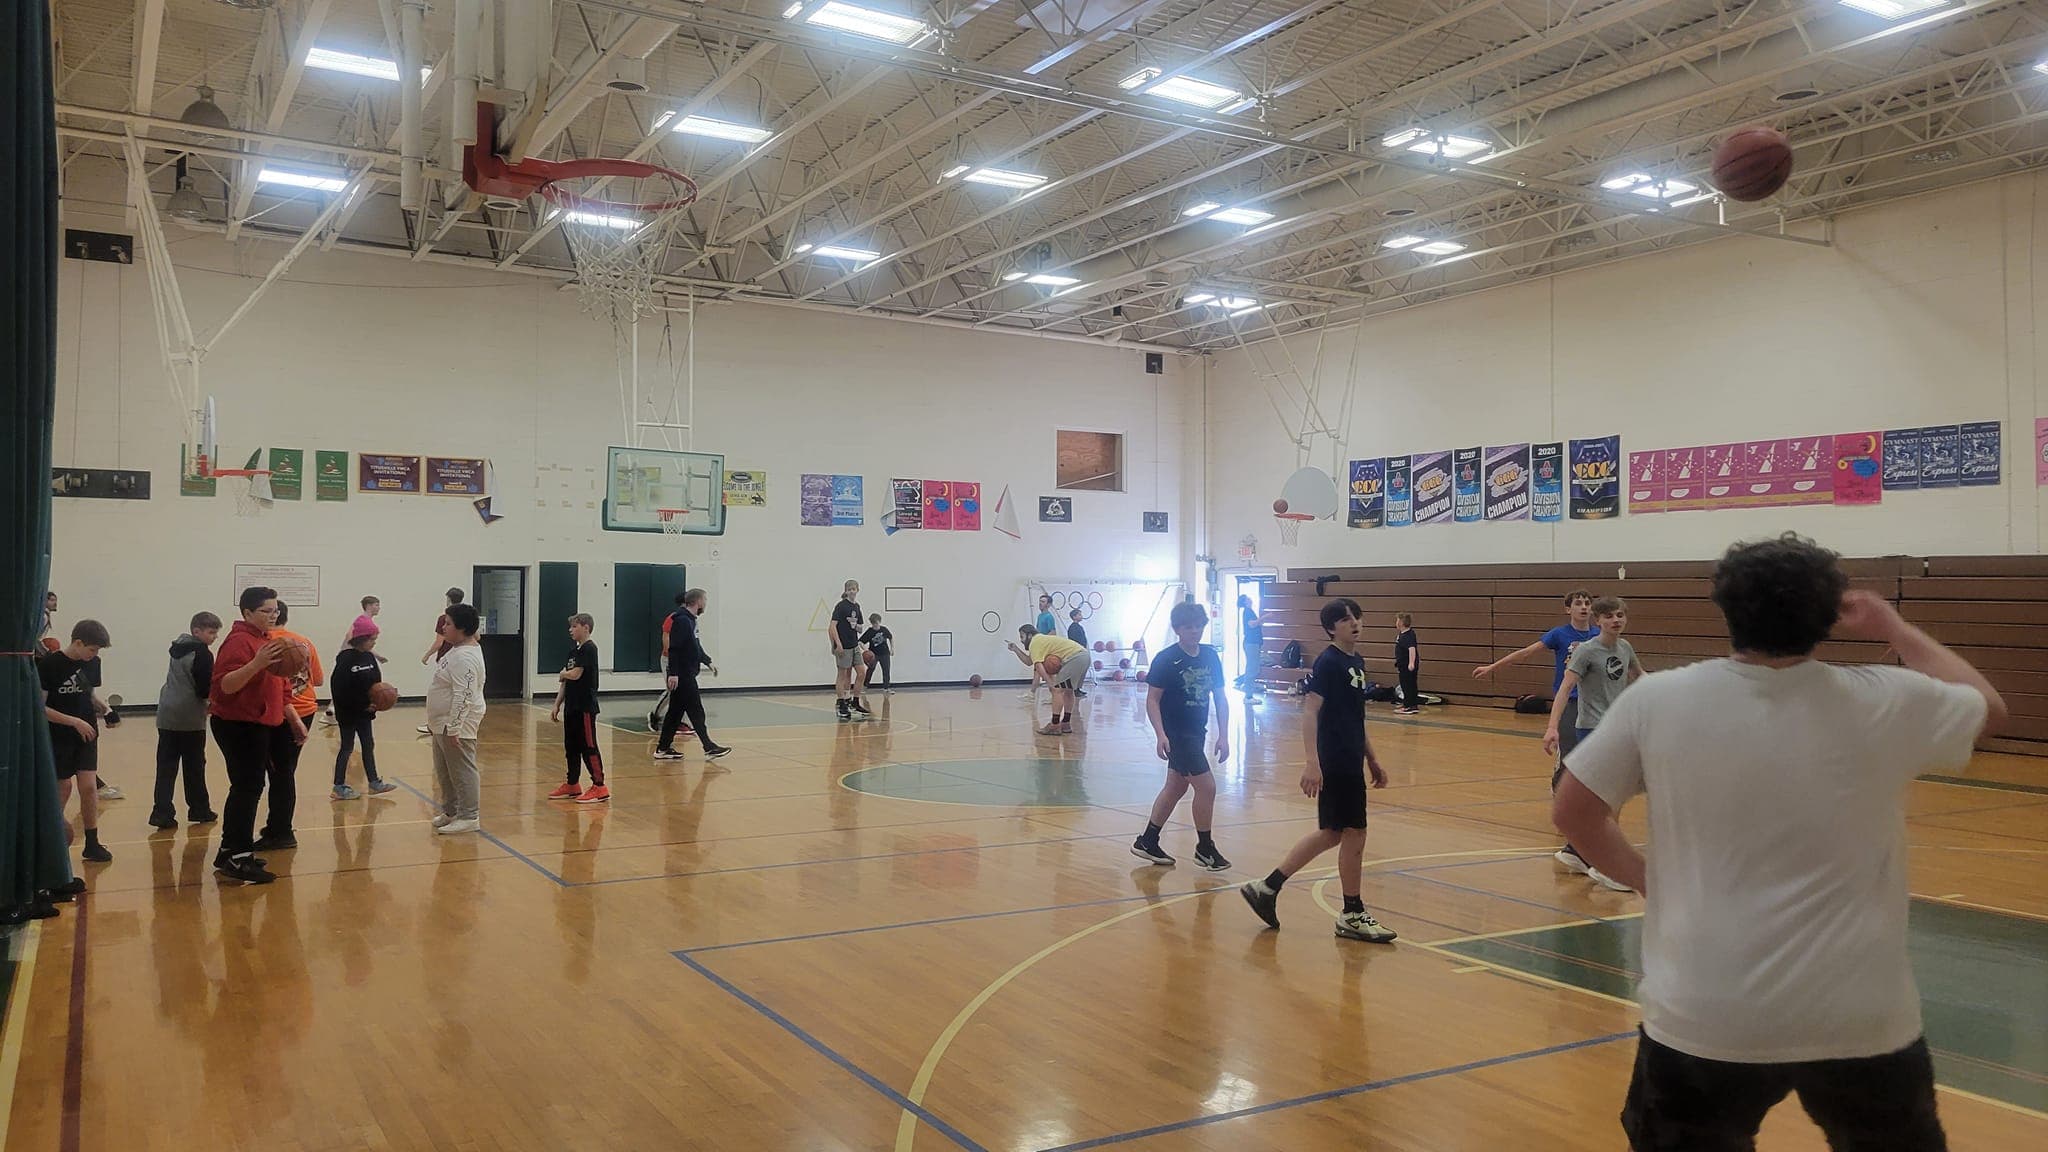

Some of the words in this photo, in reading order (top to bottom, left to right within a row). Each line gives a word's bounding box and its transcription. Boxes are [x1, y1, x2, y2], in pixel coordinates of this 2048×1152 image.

[1883, 438, 1918, 446] GYMNAST
[1921, 434, 1958, 443] GYMNAST
[1961, 431, 1999, 440] GYMNAST
[1538, 447, 1556, 456] 2020
[1883, 466, 1917, 481] Express
[1922, 464, 1957, 479] Express
[1962, 462, 1998, 476] Express
[1415, 496, 1451, 522] CHAMPION
[1488, 492, 1528, 518] CHAMPION
